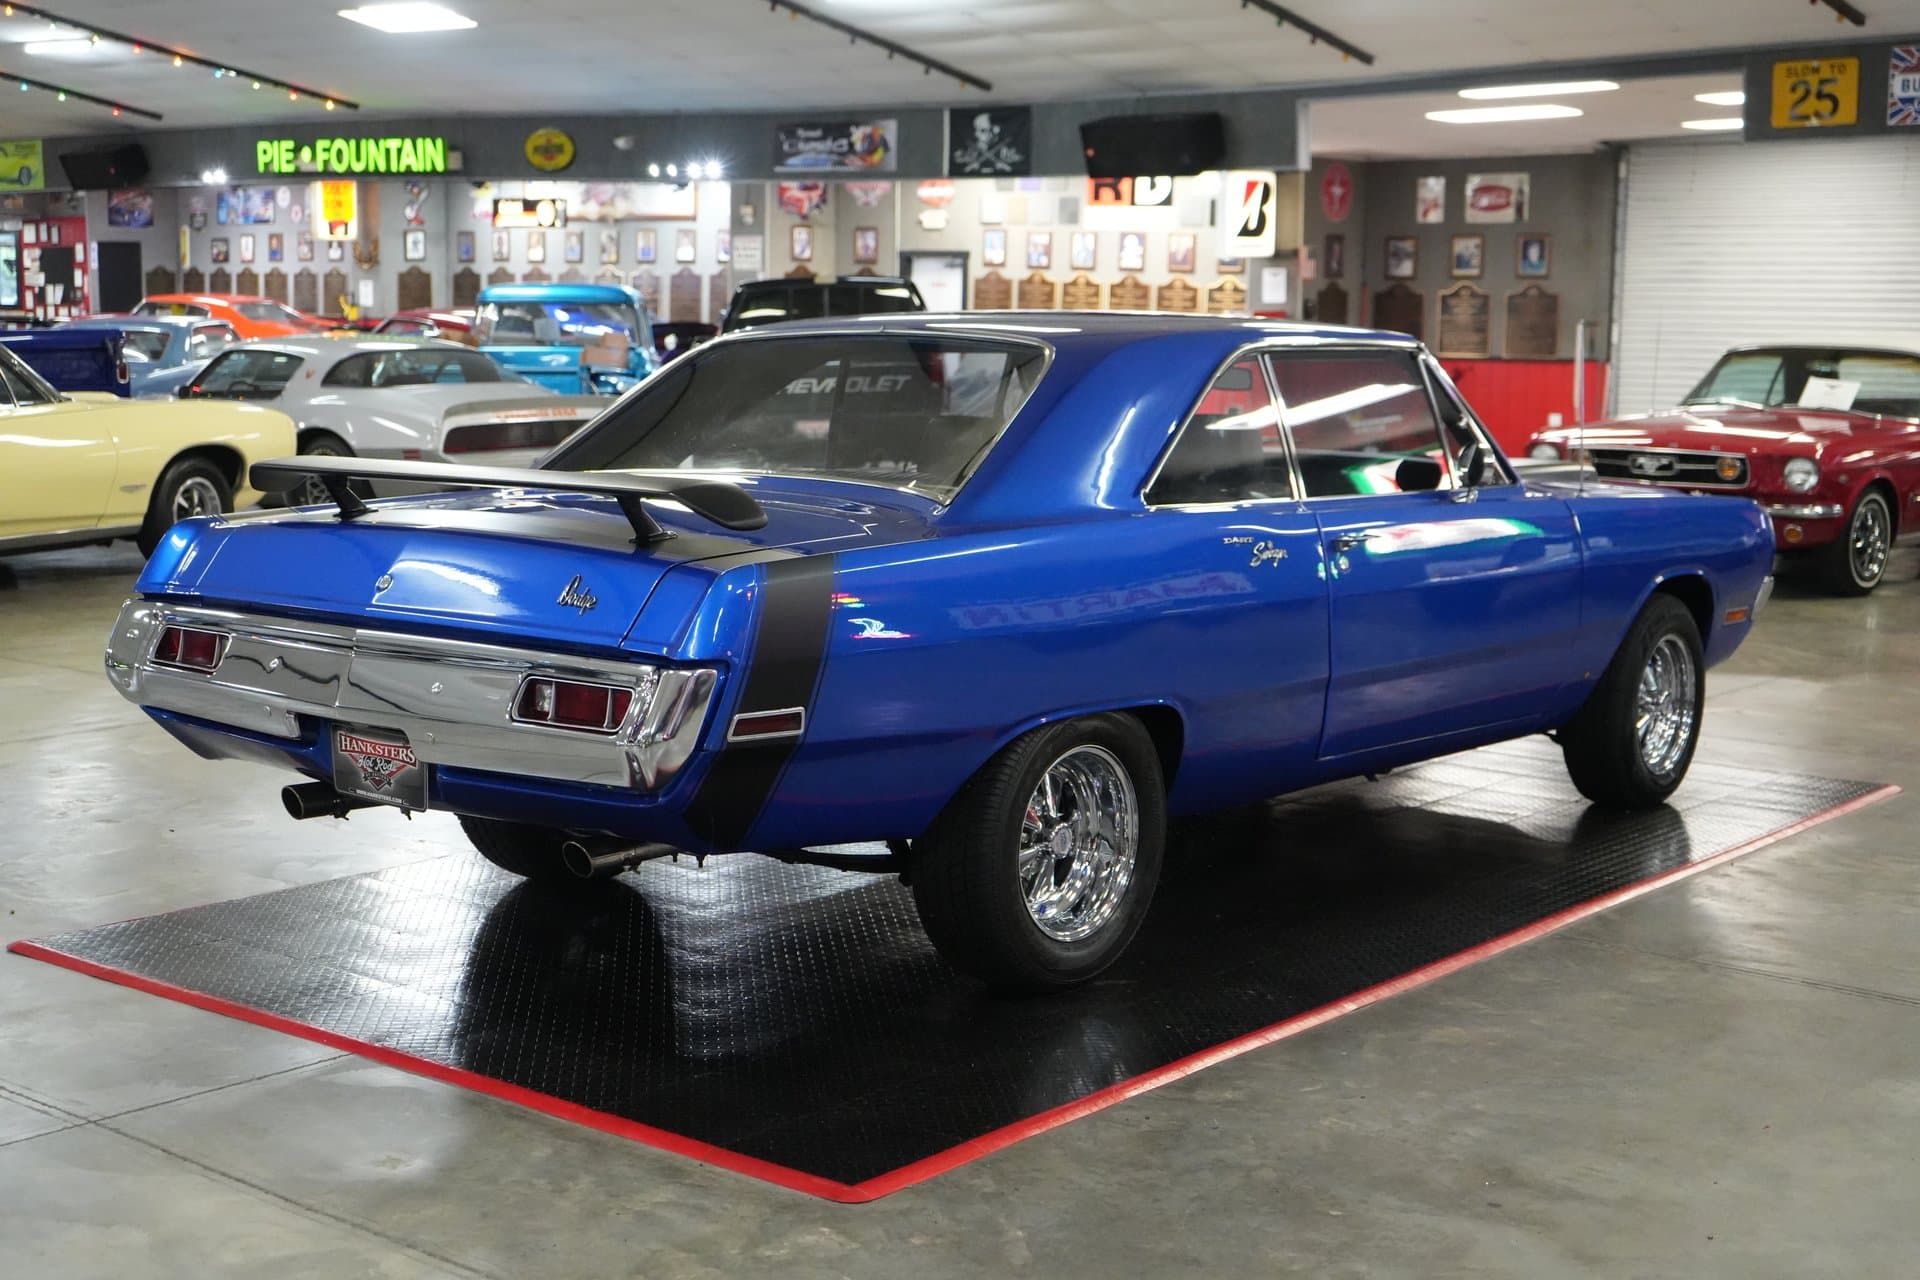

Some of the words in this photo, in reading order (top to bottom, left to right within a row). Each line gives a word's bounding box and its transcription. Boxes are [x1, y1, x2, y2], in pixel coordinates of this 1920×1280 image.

[1785, 64, 1820, 79] SLOW
[1829, 63, 1848, 75] TO
[1789, 77, 1840, 121] 25
[256, 140, 296, 174] PIE
[315, 137, 445, 174] FOUNTAIN
[776, 375, 912, 396] HEVOLET
[1223, 536, 1255, 545] DART
[340, 734, 416, 764] HANKSTERS
[358, 753, 375, 770] Hot
